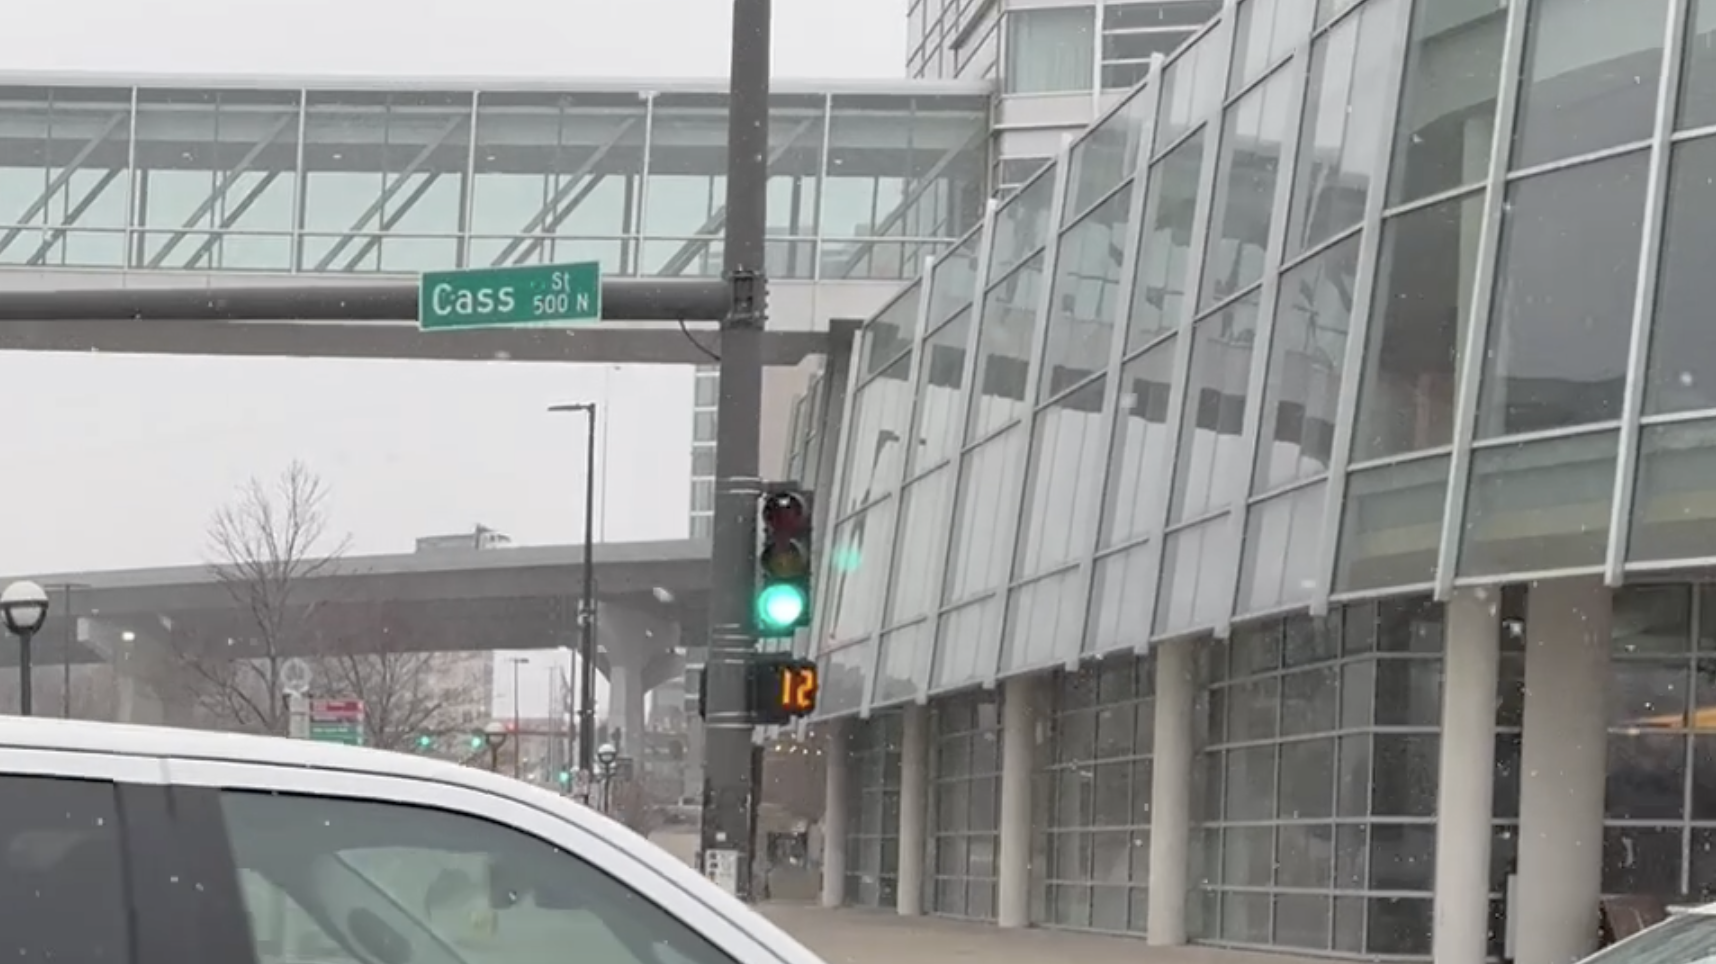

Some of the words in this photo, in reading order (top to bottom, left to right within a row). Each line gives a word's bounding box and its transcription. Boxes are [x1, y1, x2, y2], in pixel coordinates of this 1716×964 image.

[433, 283, 515, 315] Cass
[551, 271, 571, 292] St
[533, 294, 568, 315] 500
[576, 293, 588, 312] N
[782, 667, 814, 706] 12
